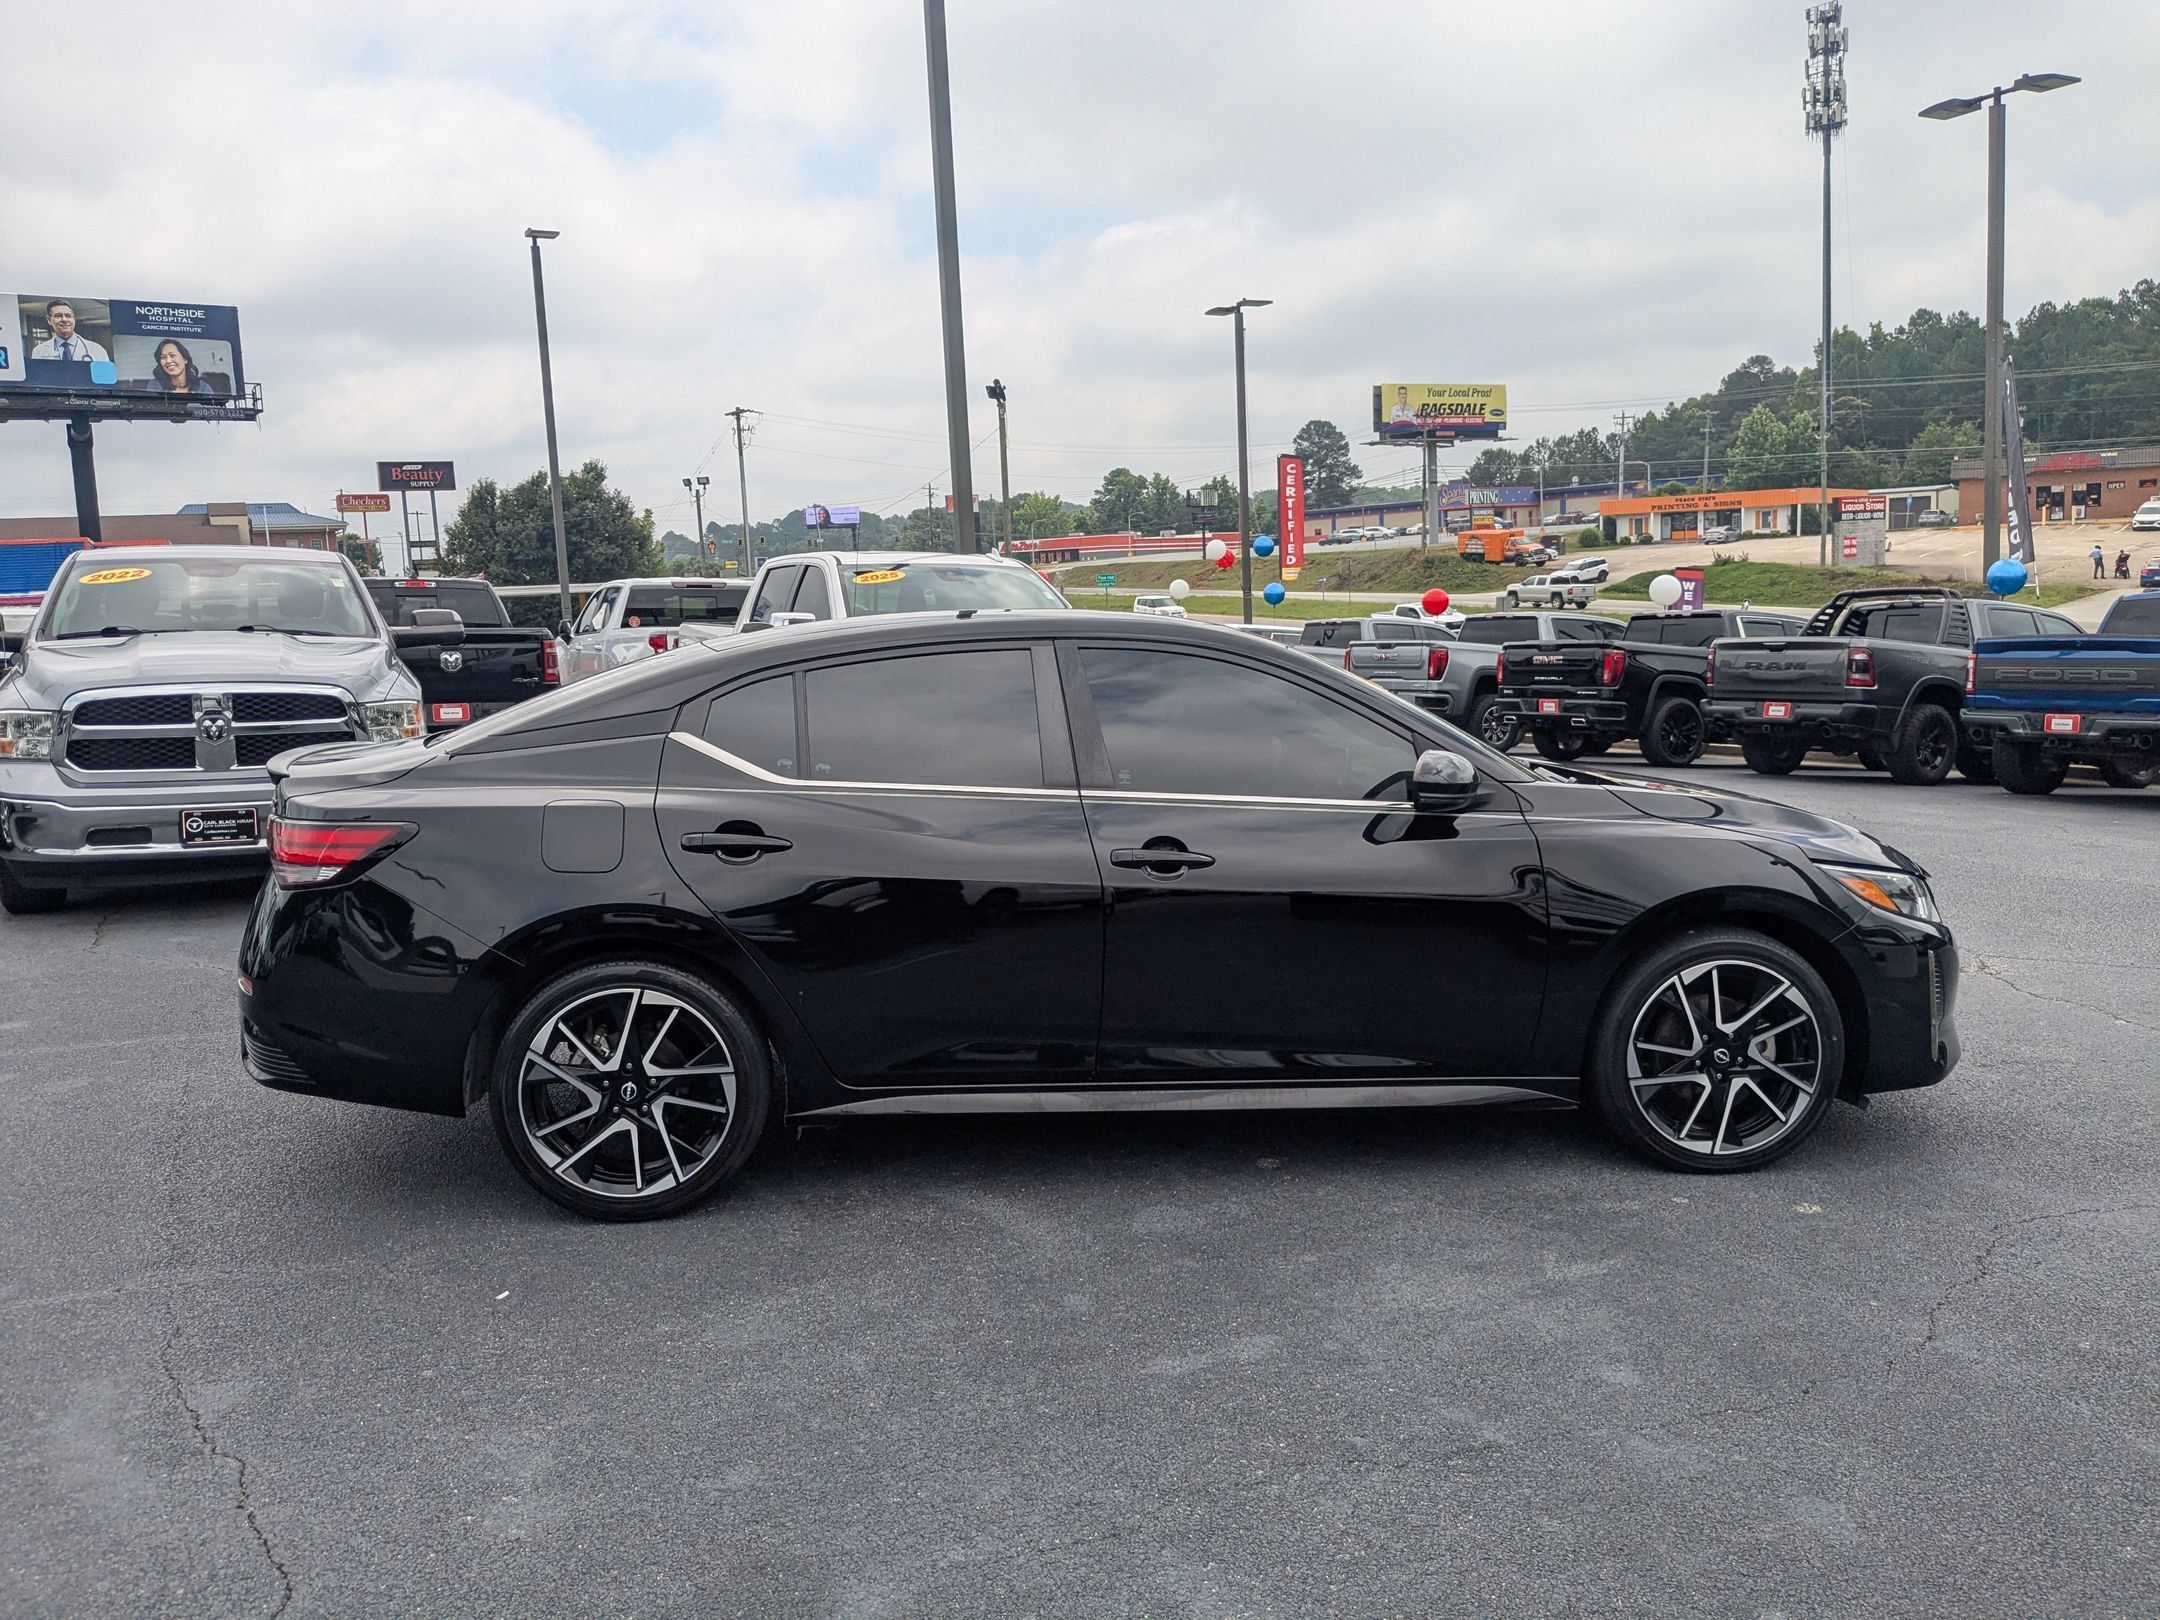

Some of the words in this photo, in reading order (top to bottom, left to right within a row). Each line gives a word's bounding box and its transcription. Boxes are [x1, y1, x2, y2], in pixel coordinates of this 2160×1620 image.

[136, 306, 205, 319] NORTHSIDE
[149, 315, 194, 324] HOSPITAL
[170, 325, 202, 333] INSTITUTE
[1427, 387, 1447, 398] Your
[1448, 387, 1470, 398] Local
[1471, 388, 1493, 398] Pros!
[1420, 403, 1487, 416] RAGSDALE
[391, 467, 443, 485] Beauty
[341, 495, 387, 506] Checkers
[1469, 490, 1499, 505] PRINTING
[1651, 502, 1699, 511] PRINTING
[1713, 500, 1743, 508] SIGNS
[1865, 502, 1885, 510] STORE
[1285, 463, 1297, 565] CERTIFIED
[87, 569, 145, 583] 2022
[860, 571, 899, 583] 2025
[1532, 655, 1564, 665] GMC
[1745, 661, 1807, 671] RAM
[1994, 668, 2139, 682] FORD
